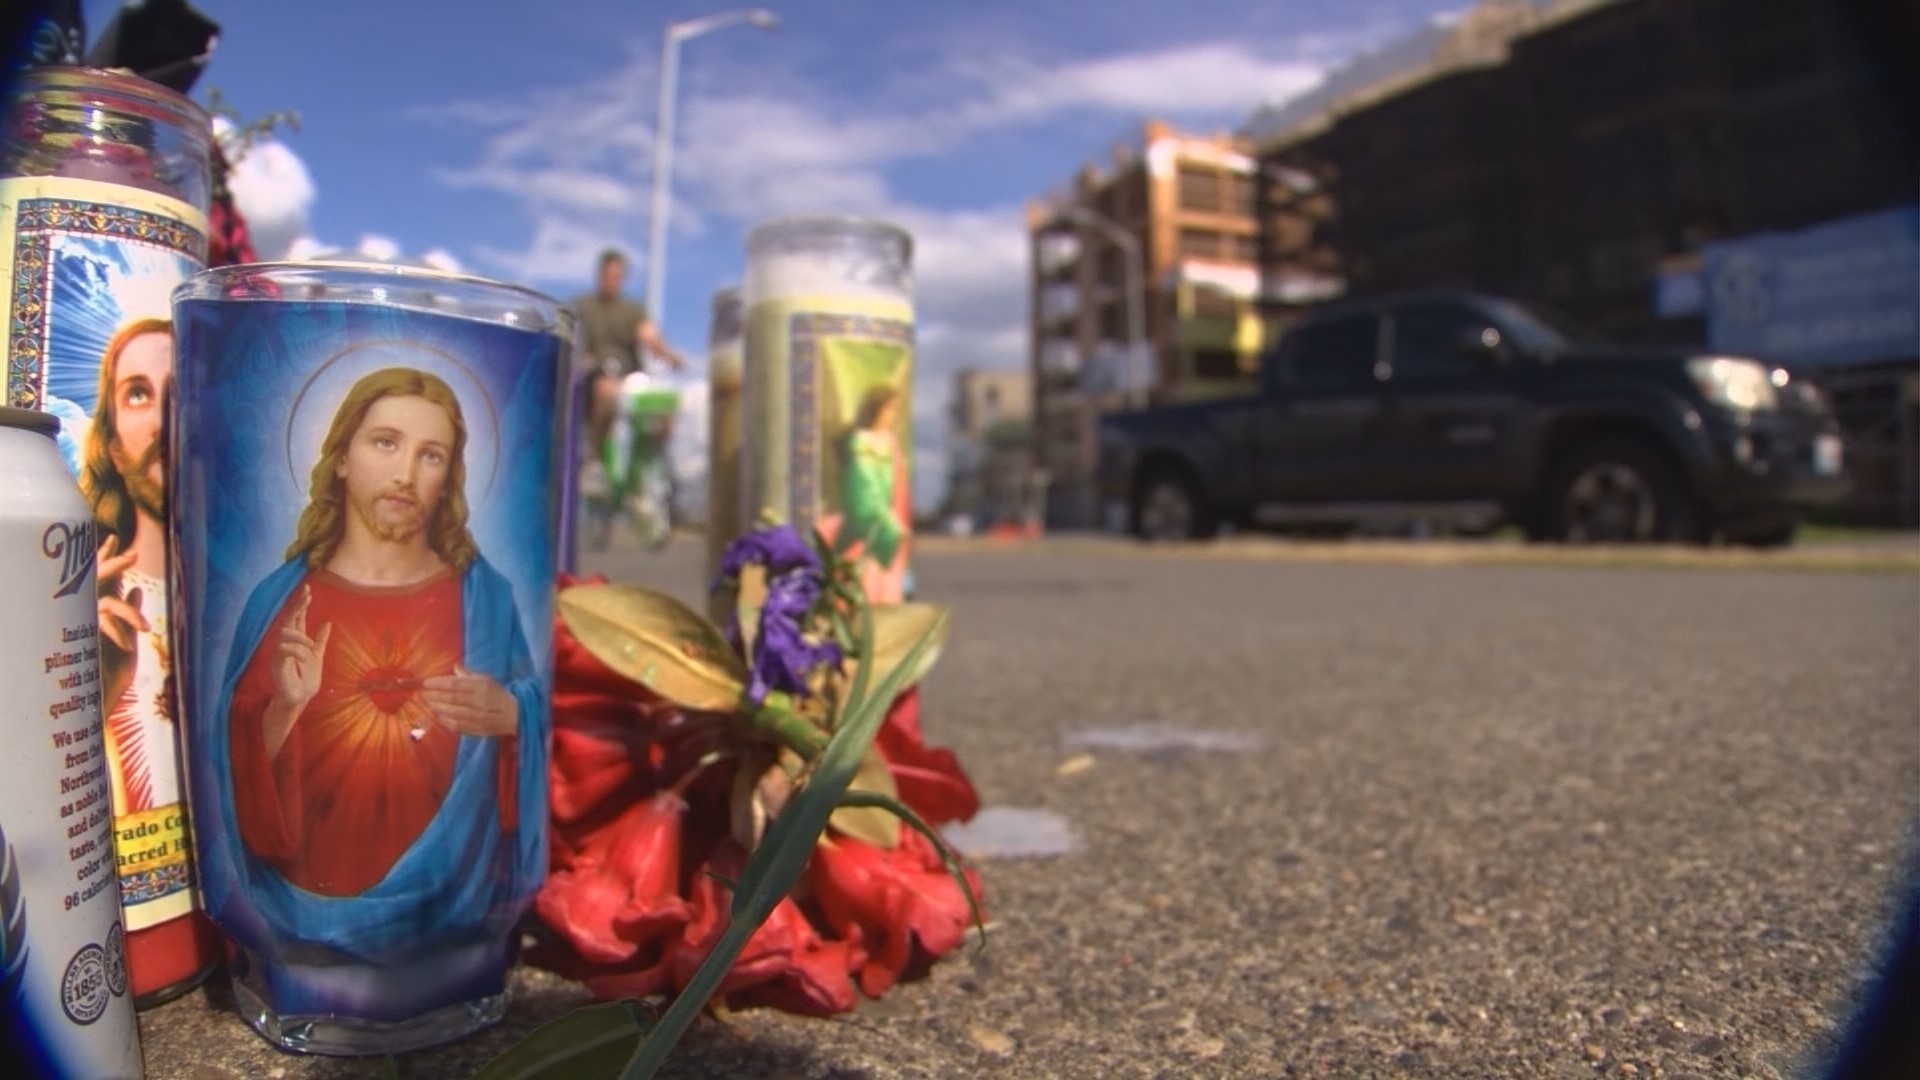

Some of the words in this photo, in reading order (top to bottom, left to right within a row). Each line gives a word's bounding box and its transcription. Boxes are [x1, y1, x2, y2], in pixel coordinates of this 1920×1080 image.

[42, 521, 97, 585] Mi
[45, 651, 82, 673] pilsner
[59, 671, 82, 690] with
[49, 695, 86, 719] quality
[52, 730, 72, 748] We
[73, 727, 88, 743] use
[65, 751, 88, 769] from
[60, 802, 74, 819] as
[67, 816, 88, 840] and
[113, 821, 159, 842] rado
[115, 842, 168, 866] acred
[77, 858, 100, 881] color
[64, 891, 80, 911] 96
